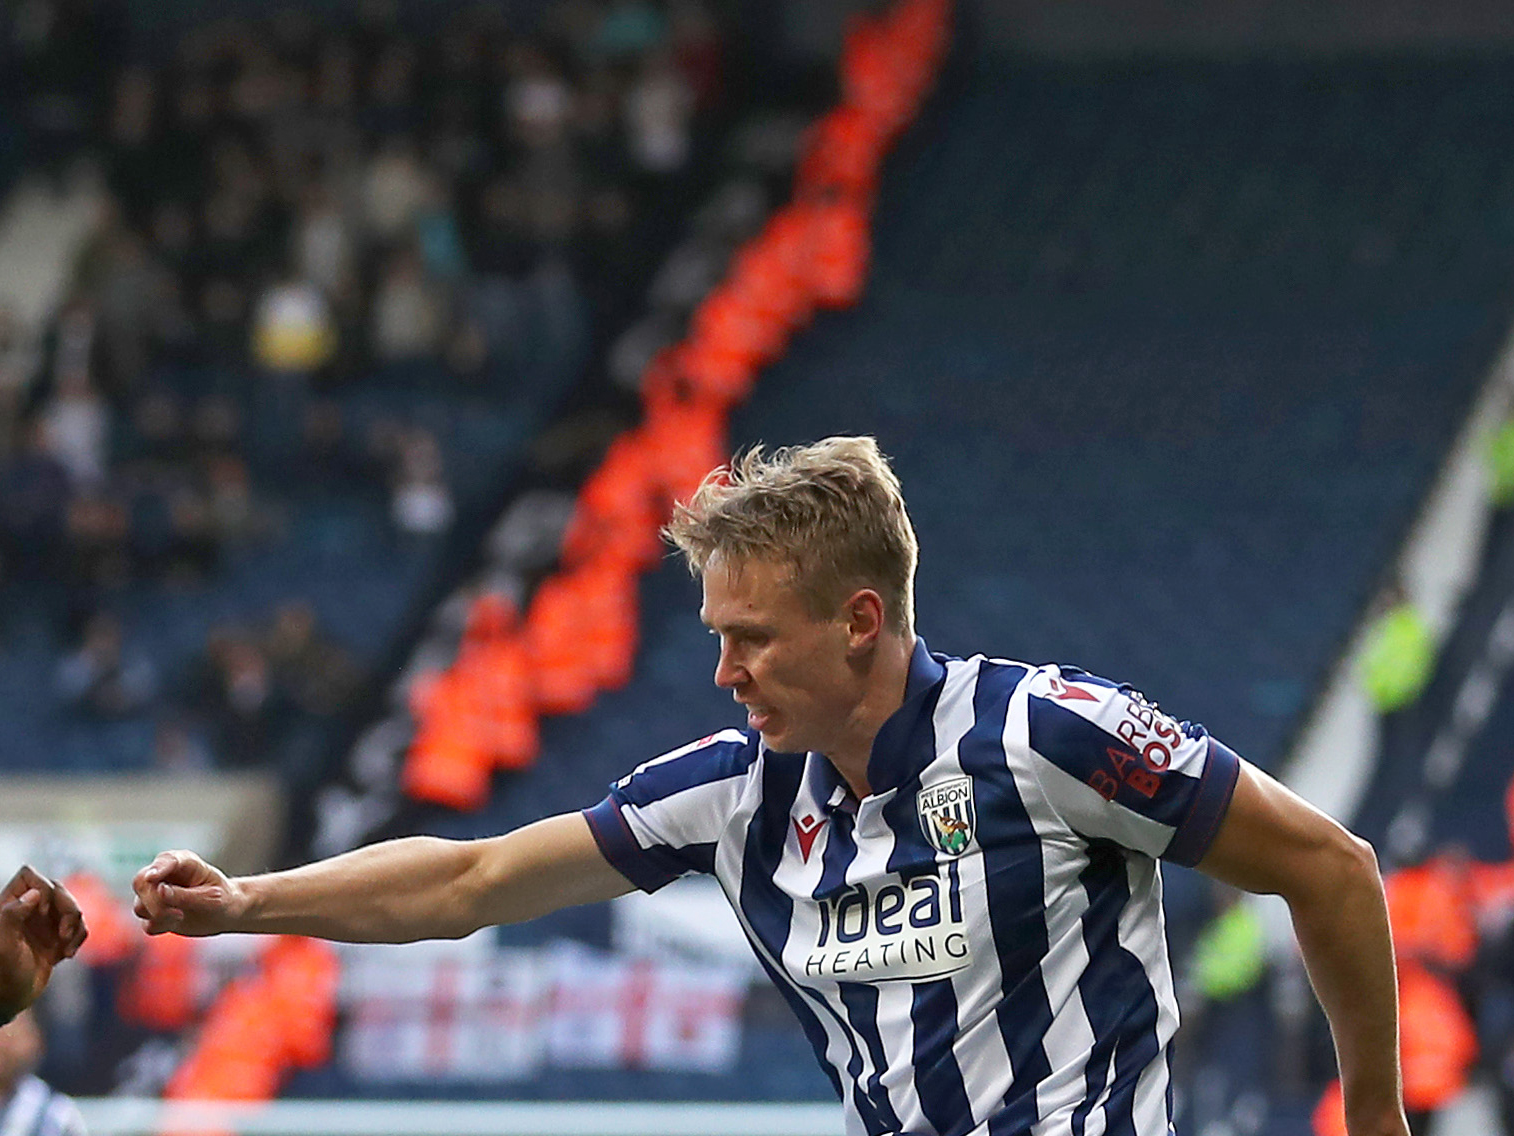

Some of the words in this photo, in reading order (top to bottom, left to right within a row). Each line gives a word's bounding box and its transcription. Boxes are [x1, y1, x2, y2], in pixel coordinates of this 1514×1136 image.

[1087, 702, 1153, 801] BARB
[1126, 720, 1181, 799] BOS
[922, 785, 968, 811] ALBION
[817, 860, 963, 948] ideal
[805, 932, 968, 977] HEATING
